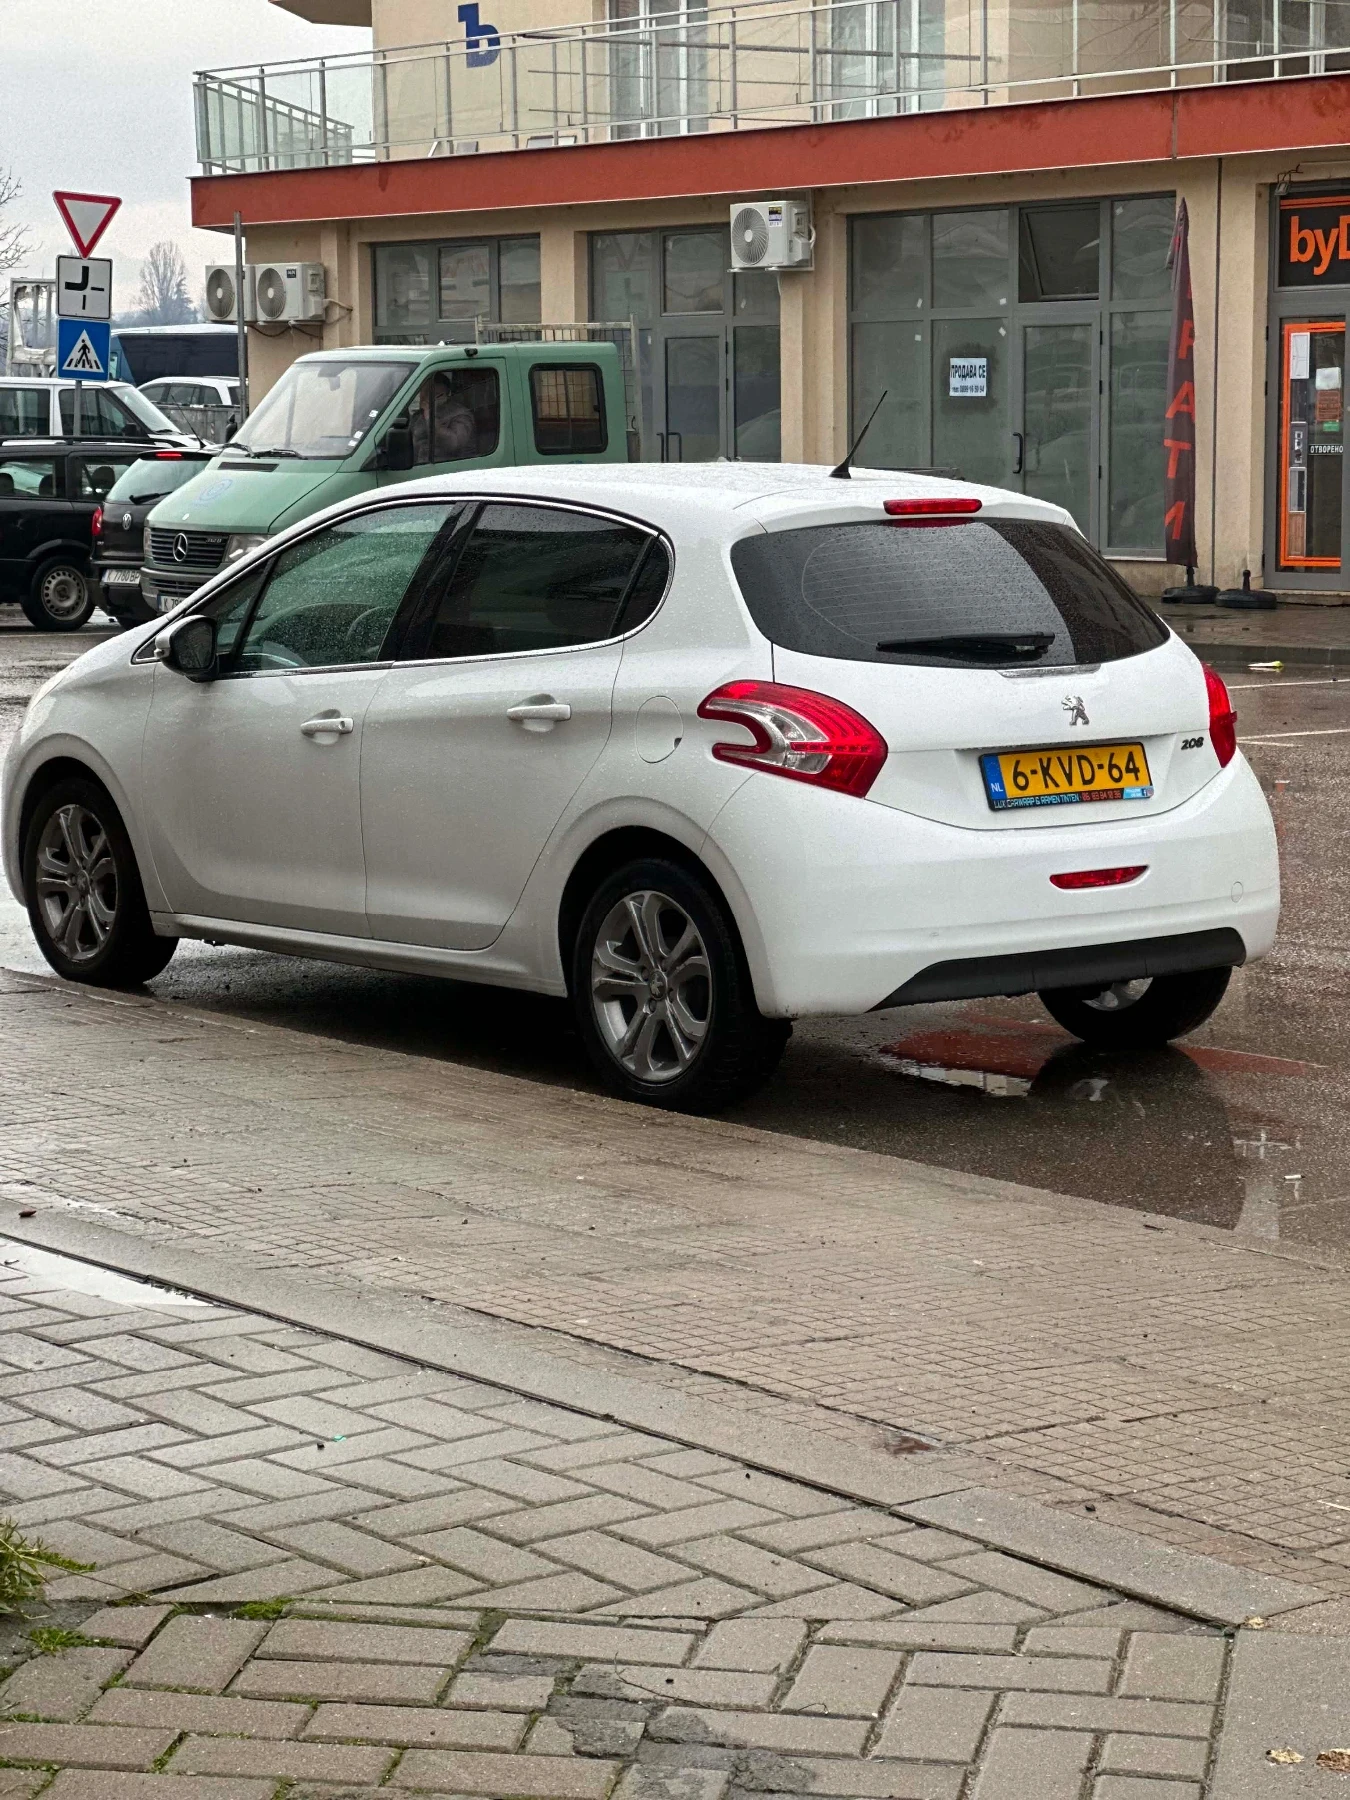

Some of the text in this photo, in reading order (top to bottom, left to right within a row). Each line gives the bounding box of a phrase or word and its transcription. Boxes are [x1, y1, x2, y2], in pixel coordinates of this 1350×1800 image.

[950, 364, 986, 381] ПРОДАВА СЕ
[1310, 445, 1344, 454] ОТВОРЕНО
[1181, 736, 1205, 750] 208
[1012, 751, 1140, 791] 6-KVD-64
[990, 782, 1004, 792] NL
[1060, 793, 1080, 803] TINTEN
